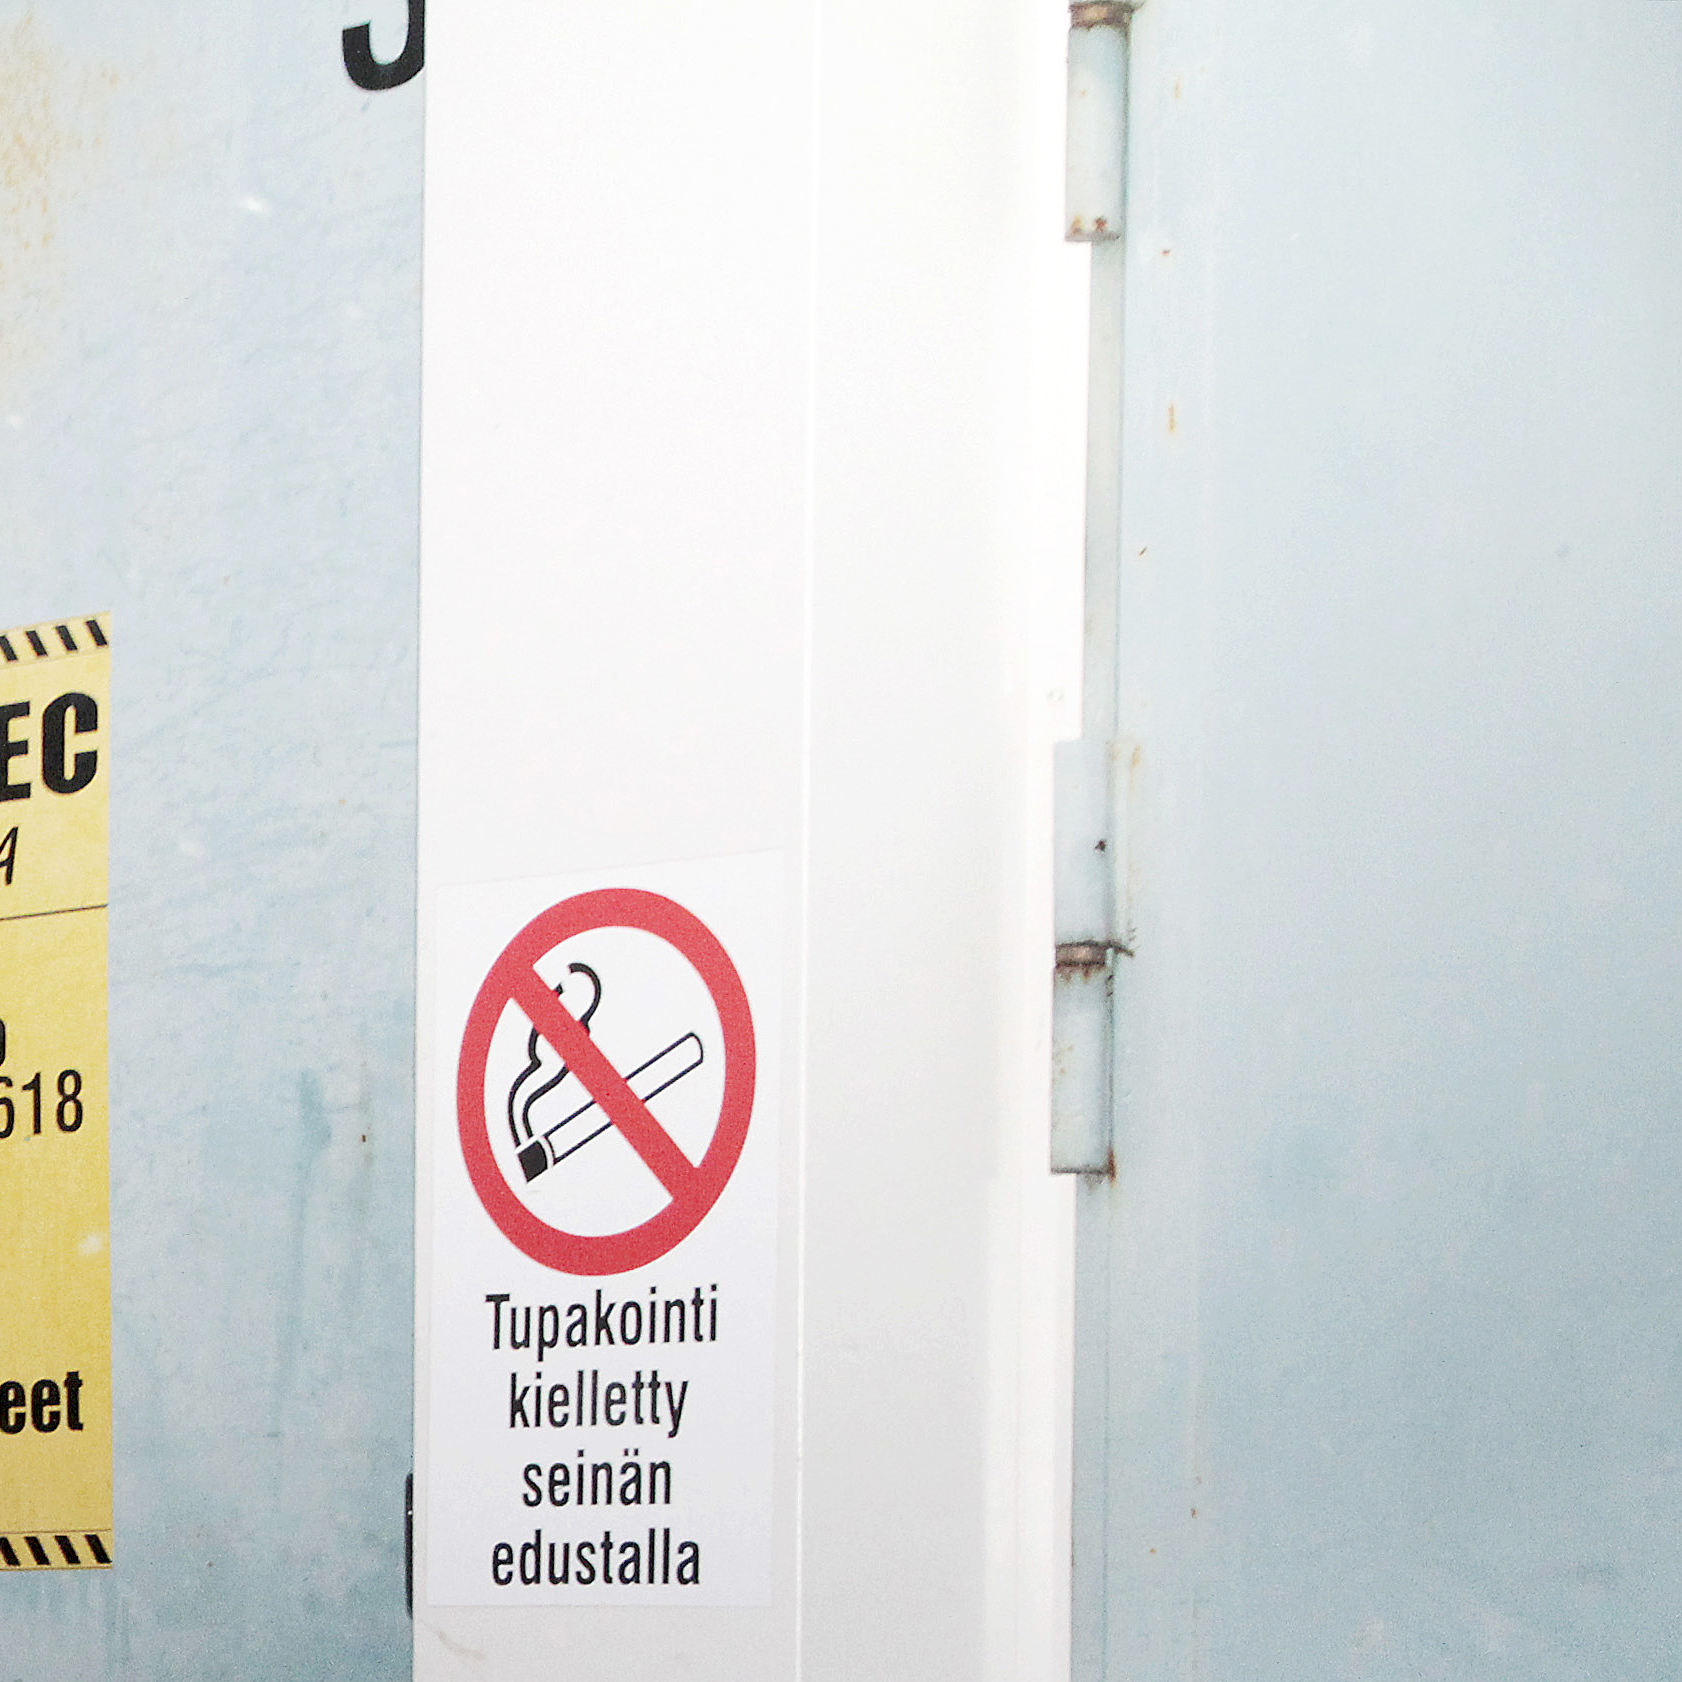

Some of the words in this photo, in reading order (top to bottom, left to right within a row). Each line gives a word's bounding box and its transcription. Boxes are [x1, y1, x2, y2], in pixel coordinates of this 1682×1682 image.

[485, 1284, 717, 1362] Tupakointi
[509, 1369, 689, 1438] kielletty
[522, 1448, 671, 1507] seinän
[492, 1528, 700, 1586] edustalla
